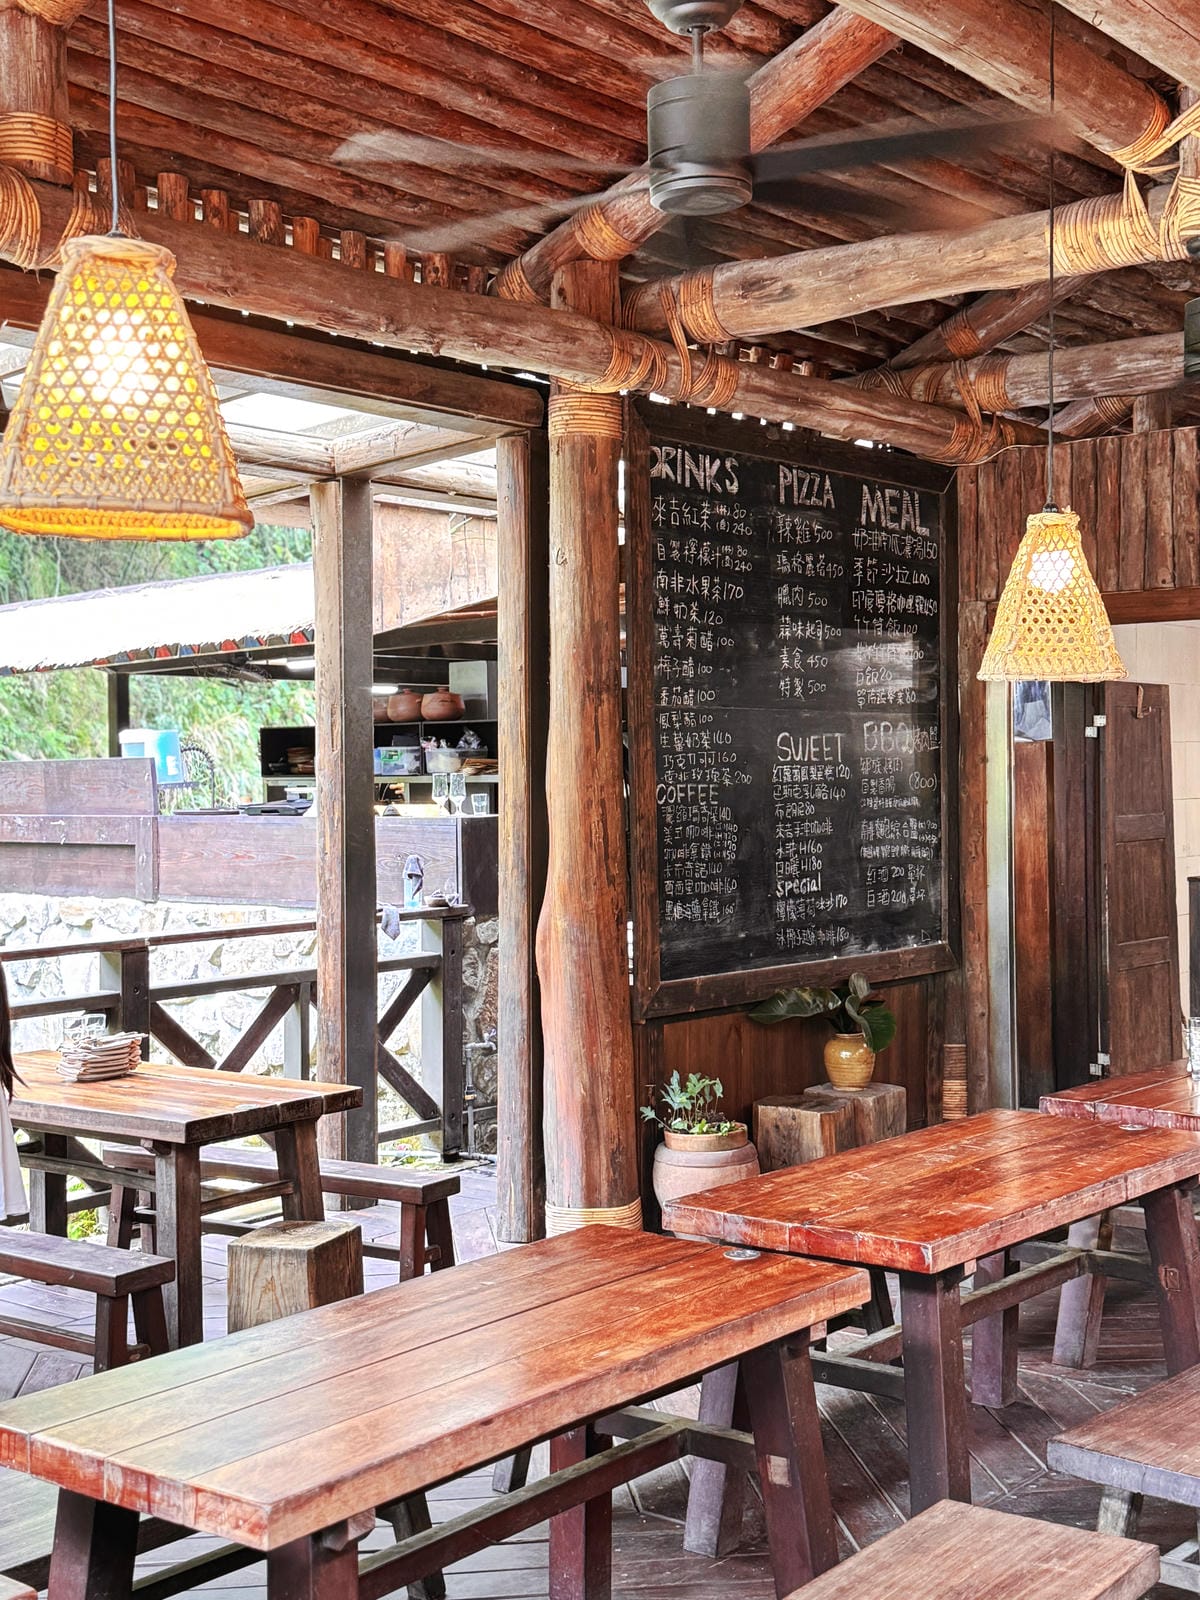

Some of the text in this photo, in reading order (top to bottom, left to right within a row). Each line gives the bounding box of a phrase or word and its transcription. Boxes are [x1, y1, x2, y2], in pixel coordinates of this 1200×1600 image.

[650, 445, 739, 494] DRINKS
[779, 464, 835, 508] PIZZA
[653, 496, 711, 532] 來吉紅茶
[733, 503, 747, 519] 80
[861, 484, 930, 537] MEAL
[732, 523, 753, 536] 240
[813, 524, 833, 543] 500
[657, 538, 721, 568] 自製檸檬汁
[737, 545, 748, 557] 80
[923, 541, 938, 559] 150
[734, 560, 753, 572] 240
[826, 562, 844, 578] 450
[853, 557, 911, 586] 季節沙拉
[656, 568, 744, 603] 南非水果茶 170
[807, 591, 828, 608] 500
[657, 596, 724, 625] 鮮奶茶 120
[824, 623, 842, 640] 500
[903, 623, 918, 637] 100
[716, 637, 735, 648] 100
[779, 646, 828, 672] 素食 450
[697, 663, 713, 674] 100
[880, 666, 893, 681] 20
[660, 686, 716, 706] 番茄醋 100
[779, 676, 827, 700] 特製 500
[659, 710, 713, 730] 鳳梨醋 100
[713, 730, 733, 744] 140
[864, 721, 913, 754] BBQ
[777, 732, 846, 763] SWEET
[717, 752, 737, 763] 160
[734, 770, 752, 785] 200
[835, 764, 850, 780] 120
[909, 771, 938, 792] (800)
[656, 784, 719, 805] COFFEE
[830, 786, 846, 800] 140
[718, 807, 731, 821] 140
[805, 801, 815, 815] 80
[890, 866, 905, 878] 200
[835, 894, 849, 909] 170
[836, 926, 850, 942] 180
